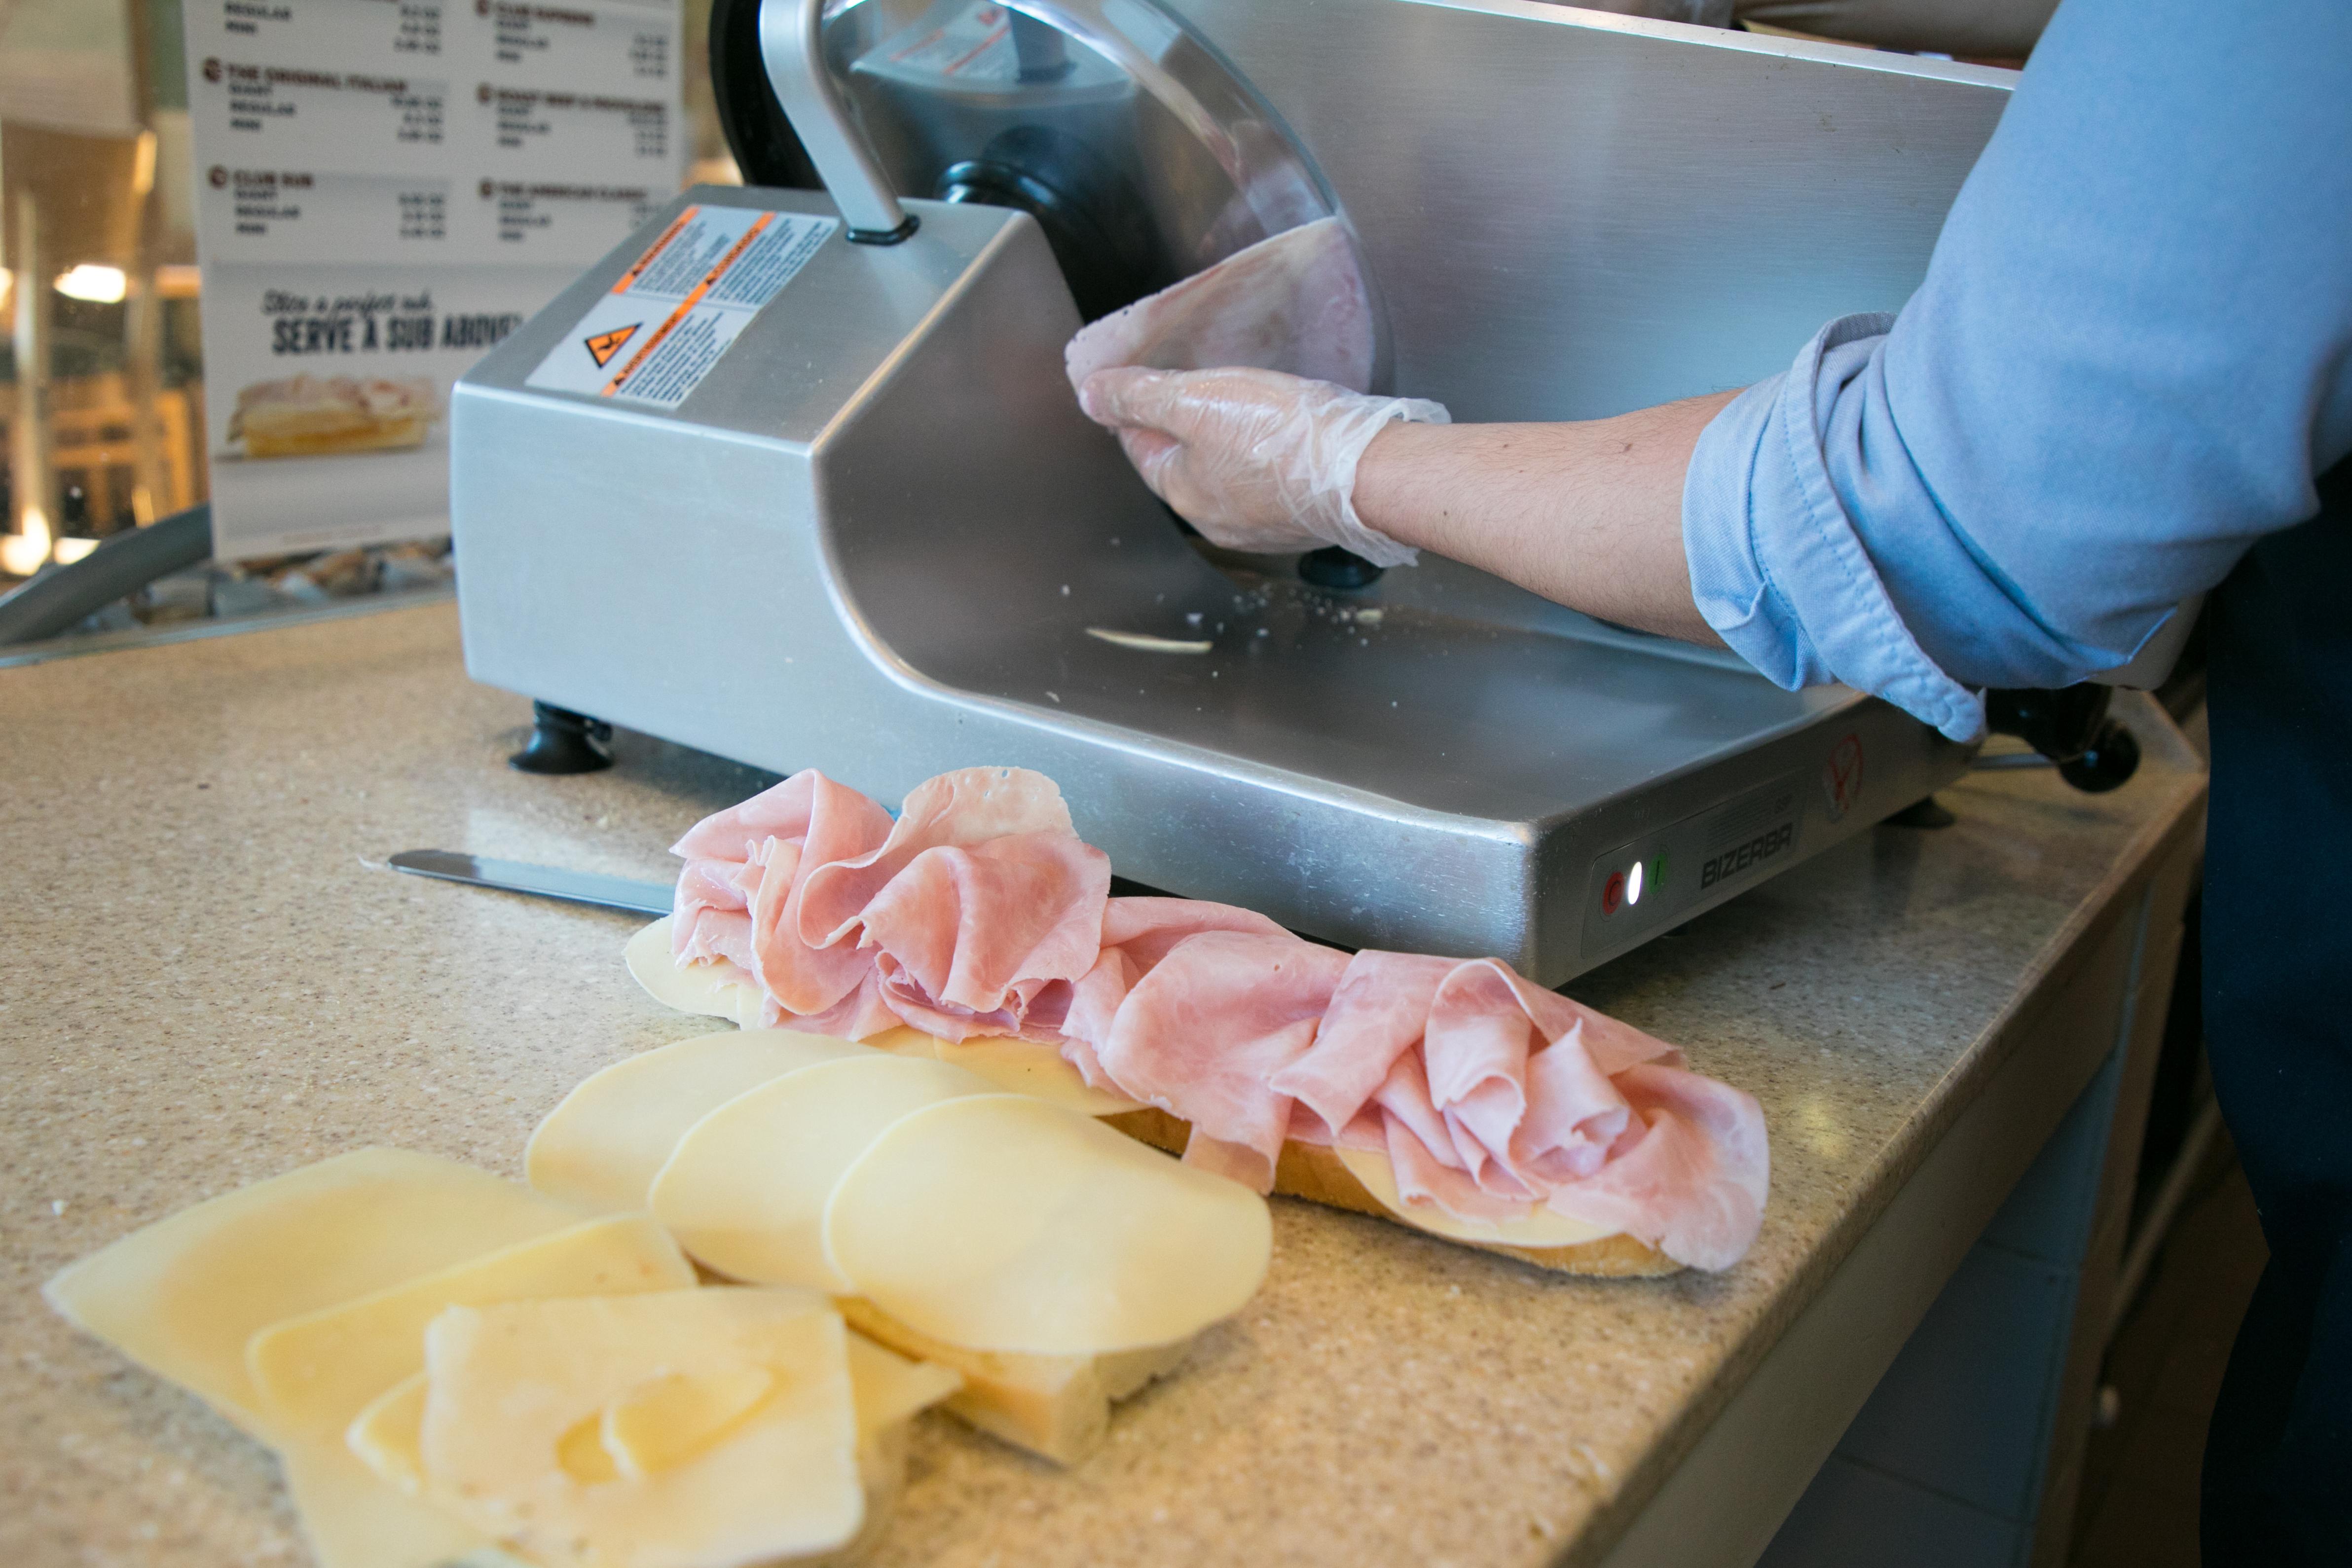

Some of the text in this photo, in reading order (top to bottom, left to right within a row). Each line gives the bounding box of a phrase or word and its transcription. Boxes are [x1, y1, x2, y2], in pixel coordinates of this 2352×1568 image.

[273, 315, 354, 356] SERVE
[363, 315, 379, 353] A
[386, 314, 435, 352] SUB
[1701, 822, 1793, 890] BIZERBA
